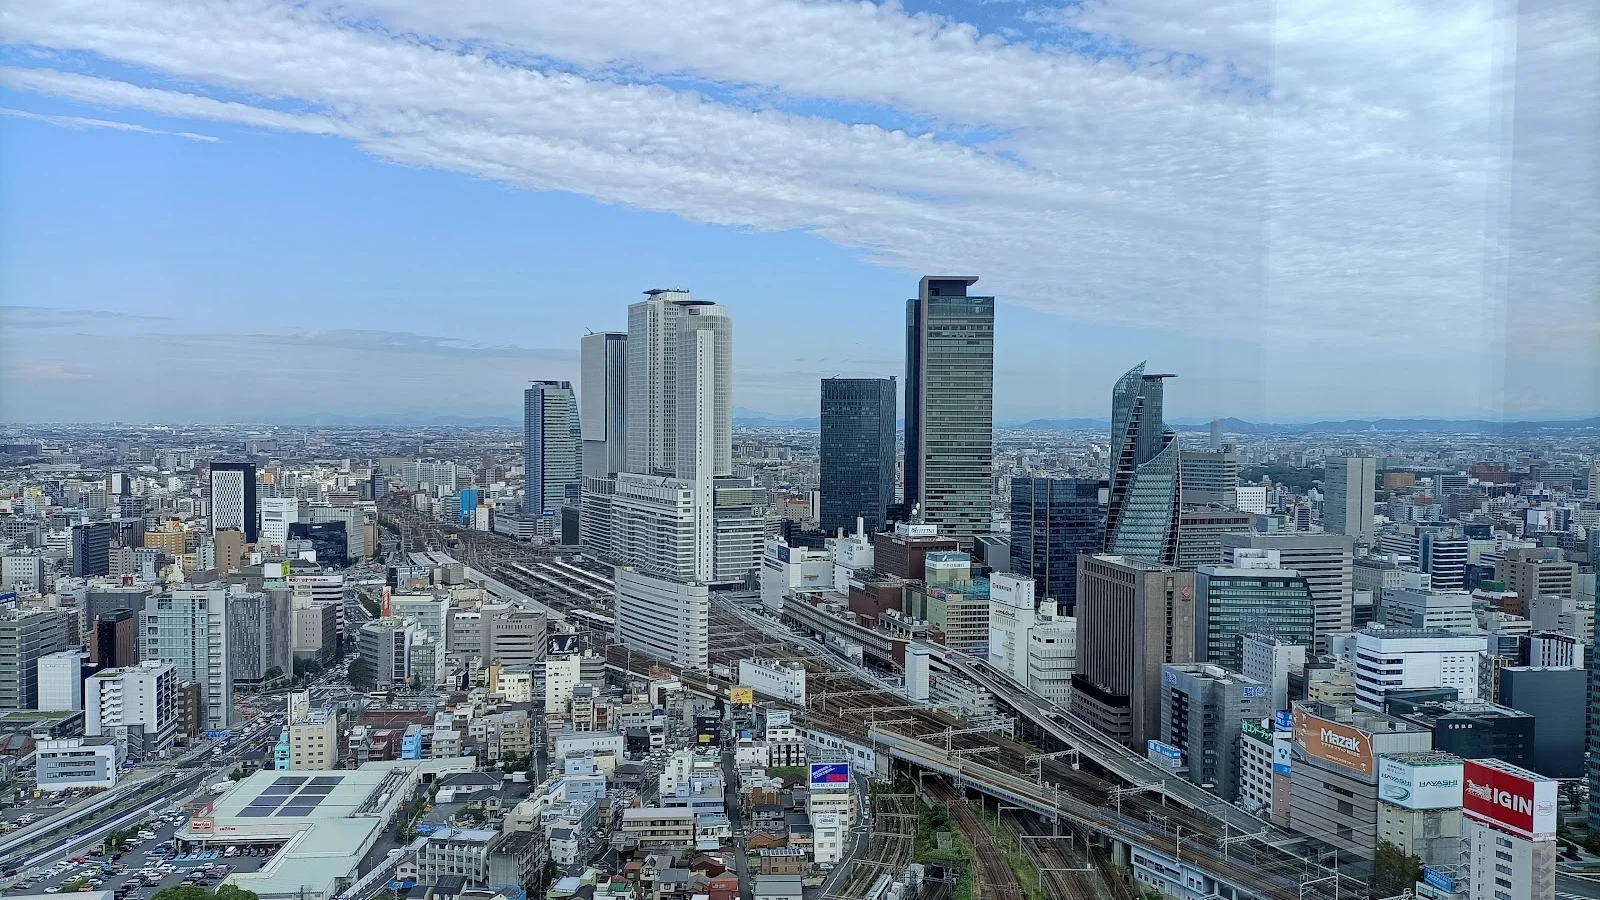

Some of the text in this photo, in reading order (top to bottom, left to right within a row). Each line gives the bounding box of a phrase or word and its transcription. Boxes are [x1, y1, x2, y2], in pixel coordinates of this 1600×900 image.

[1320, 727, 1361, 753] Mazak
[1381, 773, 1412, 787] HAYASHI
[1494, 788, 1532, 816] IGIN
